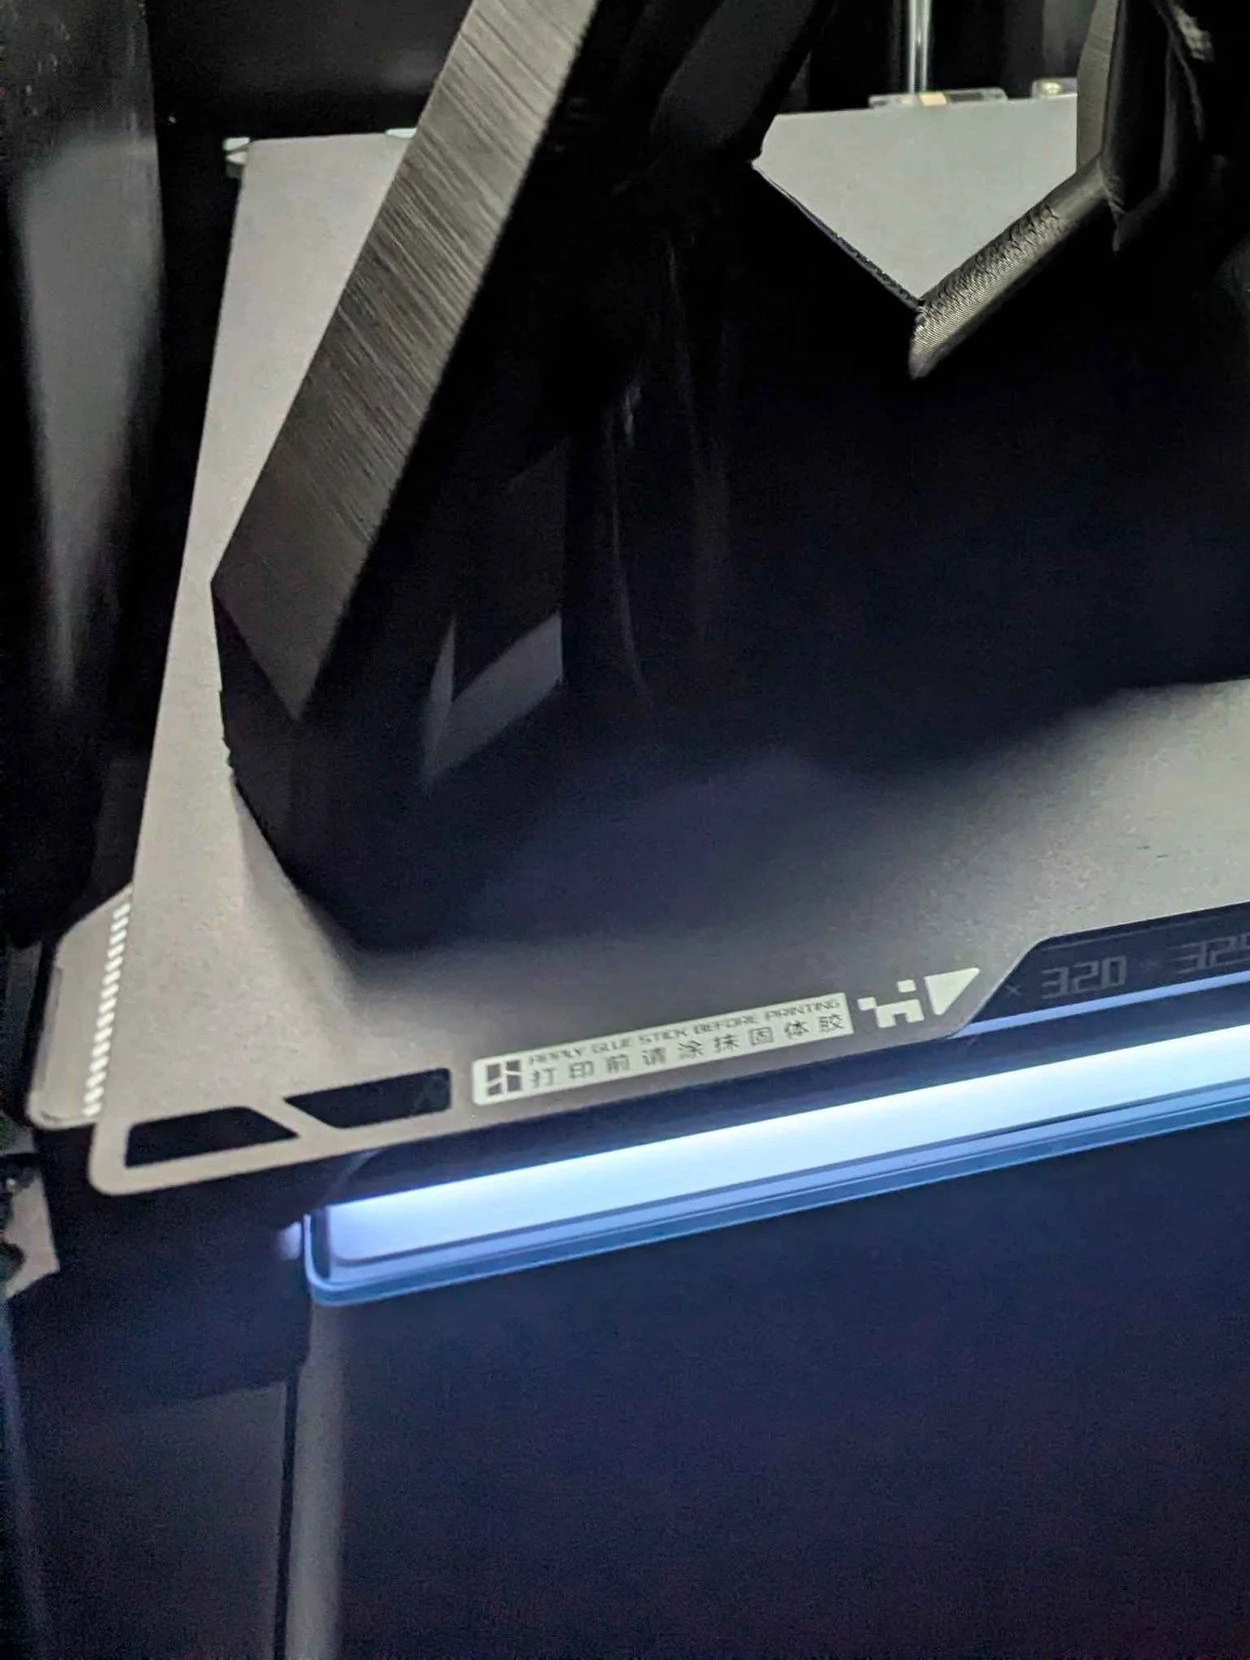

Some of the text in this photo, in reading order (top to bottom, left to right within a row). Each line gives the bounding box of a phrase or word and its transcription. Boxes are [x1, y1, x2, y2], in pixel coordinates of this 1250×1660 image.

[1040, 954, 1128, 1000] 320
[529, 1012, 845, 1089] 打印前请涂抹固体胶
[590, 1037, 632, 1054] GLUE
[638, 1028, 689, 1045] STICK
[693, 1015, 760, 1035] BEFORE
[764, 998, 842, 1021] PRINTING
